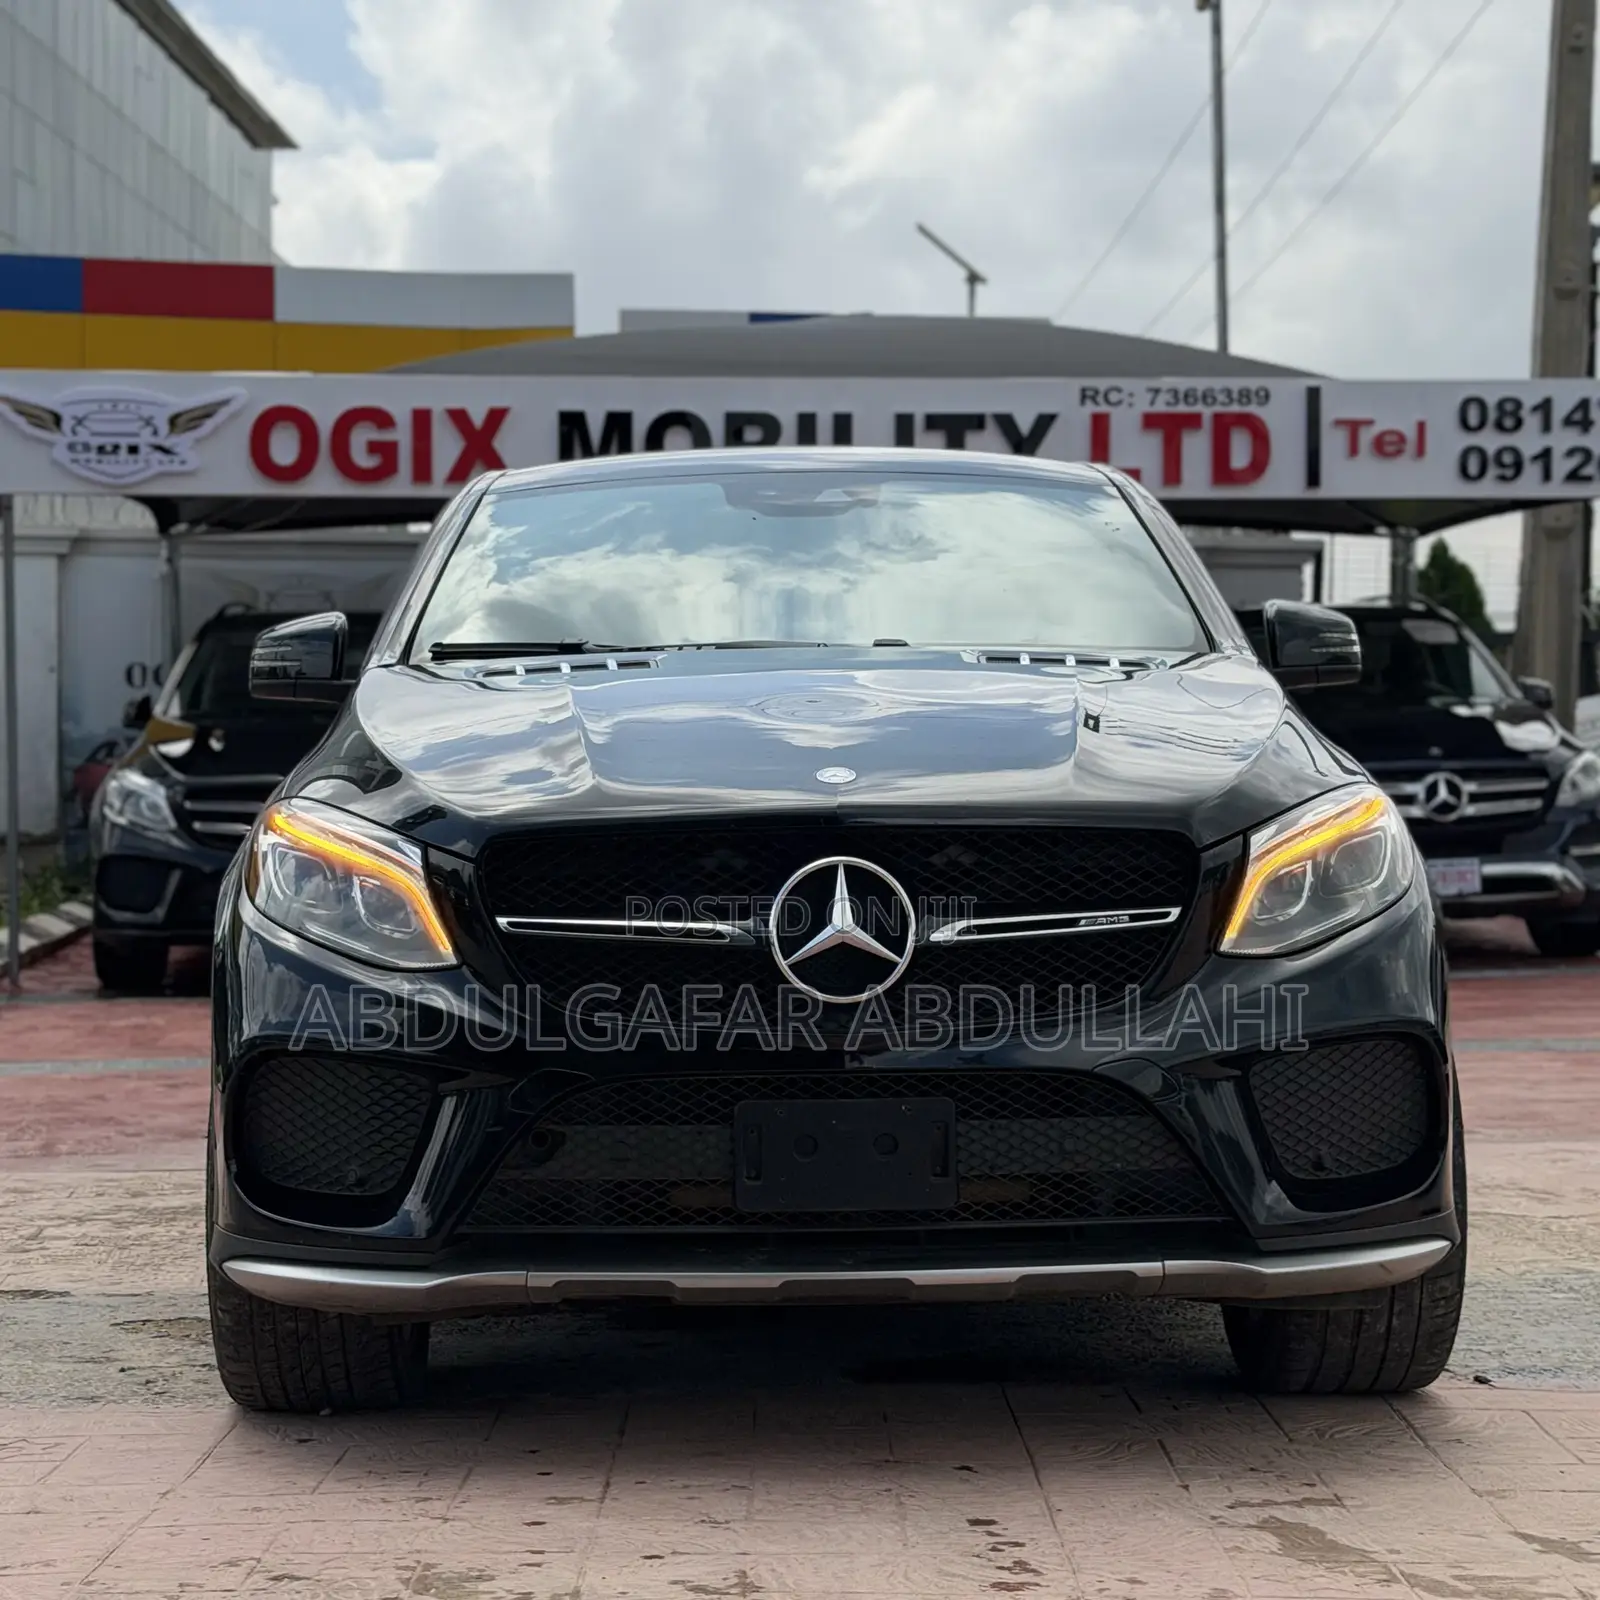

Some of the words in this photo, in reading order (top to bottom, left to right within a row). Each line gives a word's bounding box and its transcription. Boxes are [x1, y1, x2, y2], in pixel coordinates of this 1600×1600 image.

[1079, 386, 1135, 408] RC:
[1146, 386, 1271, 407] 7366389
[1459, 396, 1600, 434] 0814
[249, 405, 510, 485] OGIX
[1090, 411, 1271, 487] LTD
[1333, 418, 1426, 459] Tel
[1459, 445, 1600, 483] 0912
